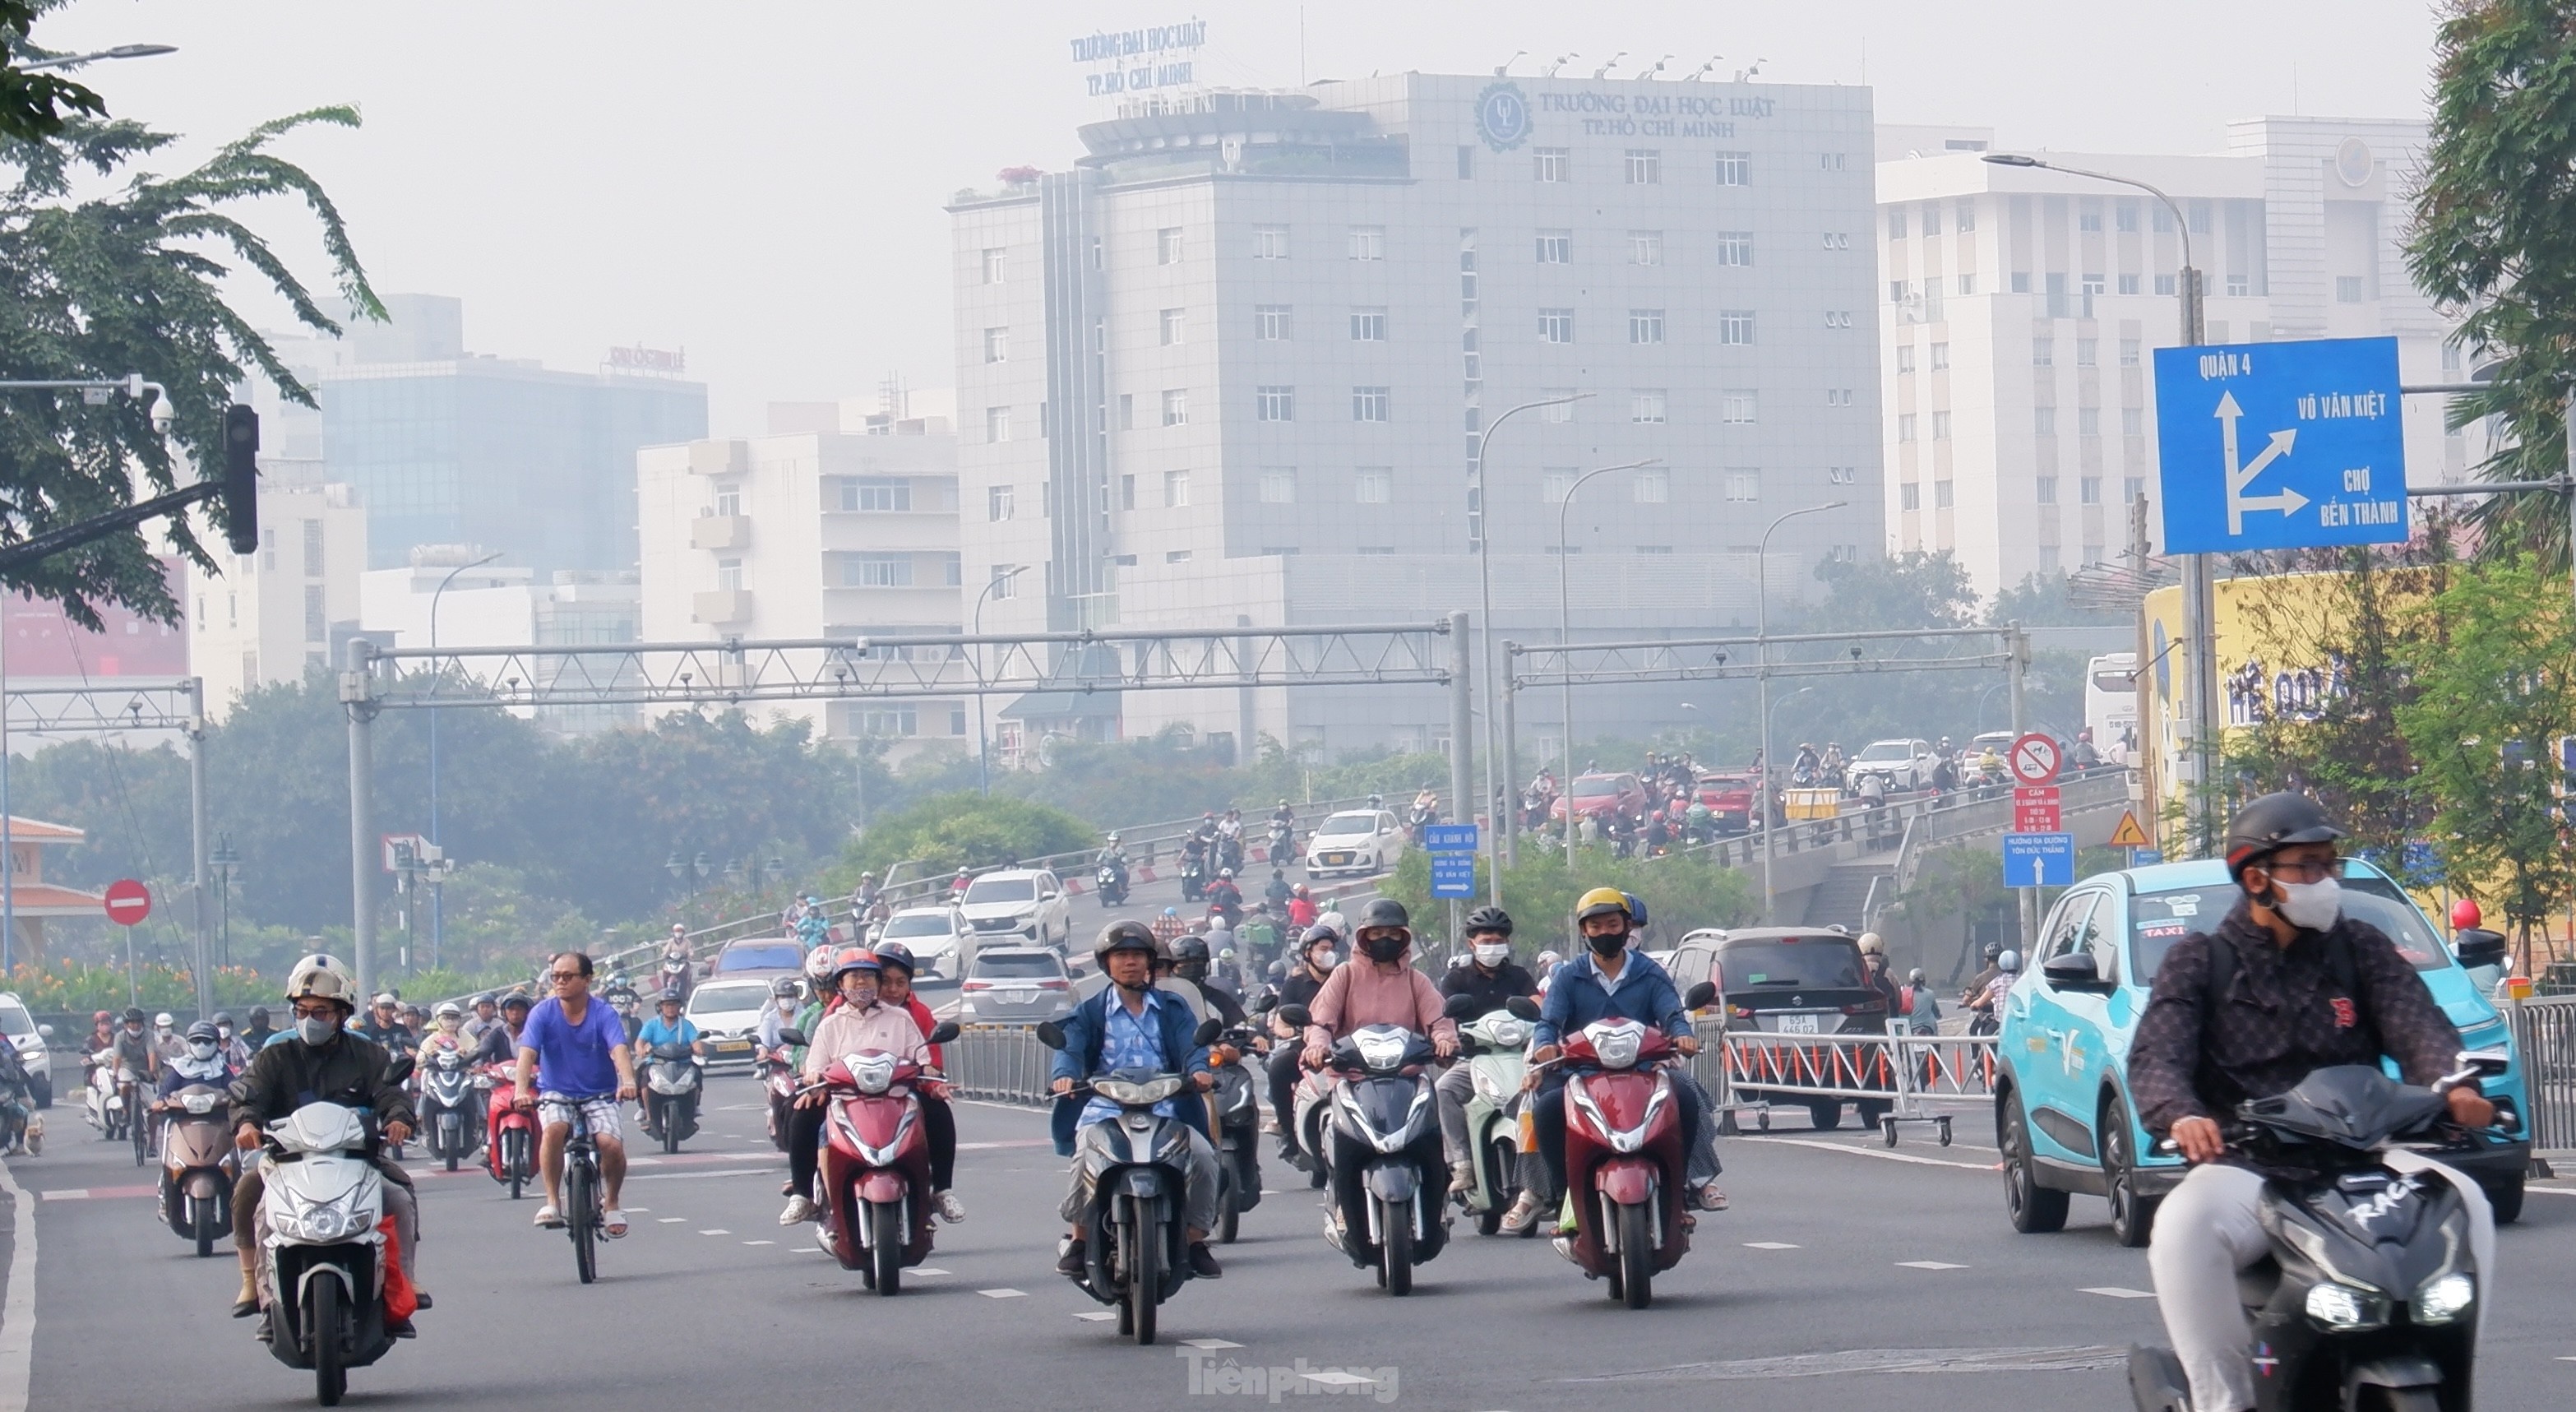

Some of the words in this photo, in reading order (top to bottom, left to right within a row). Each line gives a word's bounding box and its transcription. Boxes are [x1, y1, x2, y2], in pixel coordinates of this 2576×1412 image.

[1158, 62, 1192, 86] MINH
[1538, 90, 1626, 113] TRƯỜNG
[1634, 96, 1670, 118] ĐẠI
[1676, 97, 1722, 118] HỌC
[1730, 95, 1776, 120] LUẬT
[1642, 118, 1676, 137] CHÍ
[1682, 122, 1736, 138] MINH
[2199, 350, 2237, 381] QUẬN
[2241, 353, 2251, 376] 4
[2298, 392, 2316, 420] VÕ
[2321, 391, 2351, 418] VĂN
[2355, 390, 2386, 420] KIỆT
[2343, 465, 2370, 496] CHỢ
[2320, 496, 2349, 526] BẾN
[2352, 498, 2398, 525] THÀNH
[2028, 787, 2045, 797] CẤM
[2012, 846, 2025, 854] TÔN
[2146, 926, 2185, 937] TAXI
